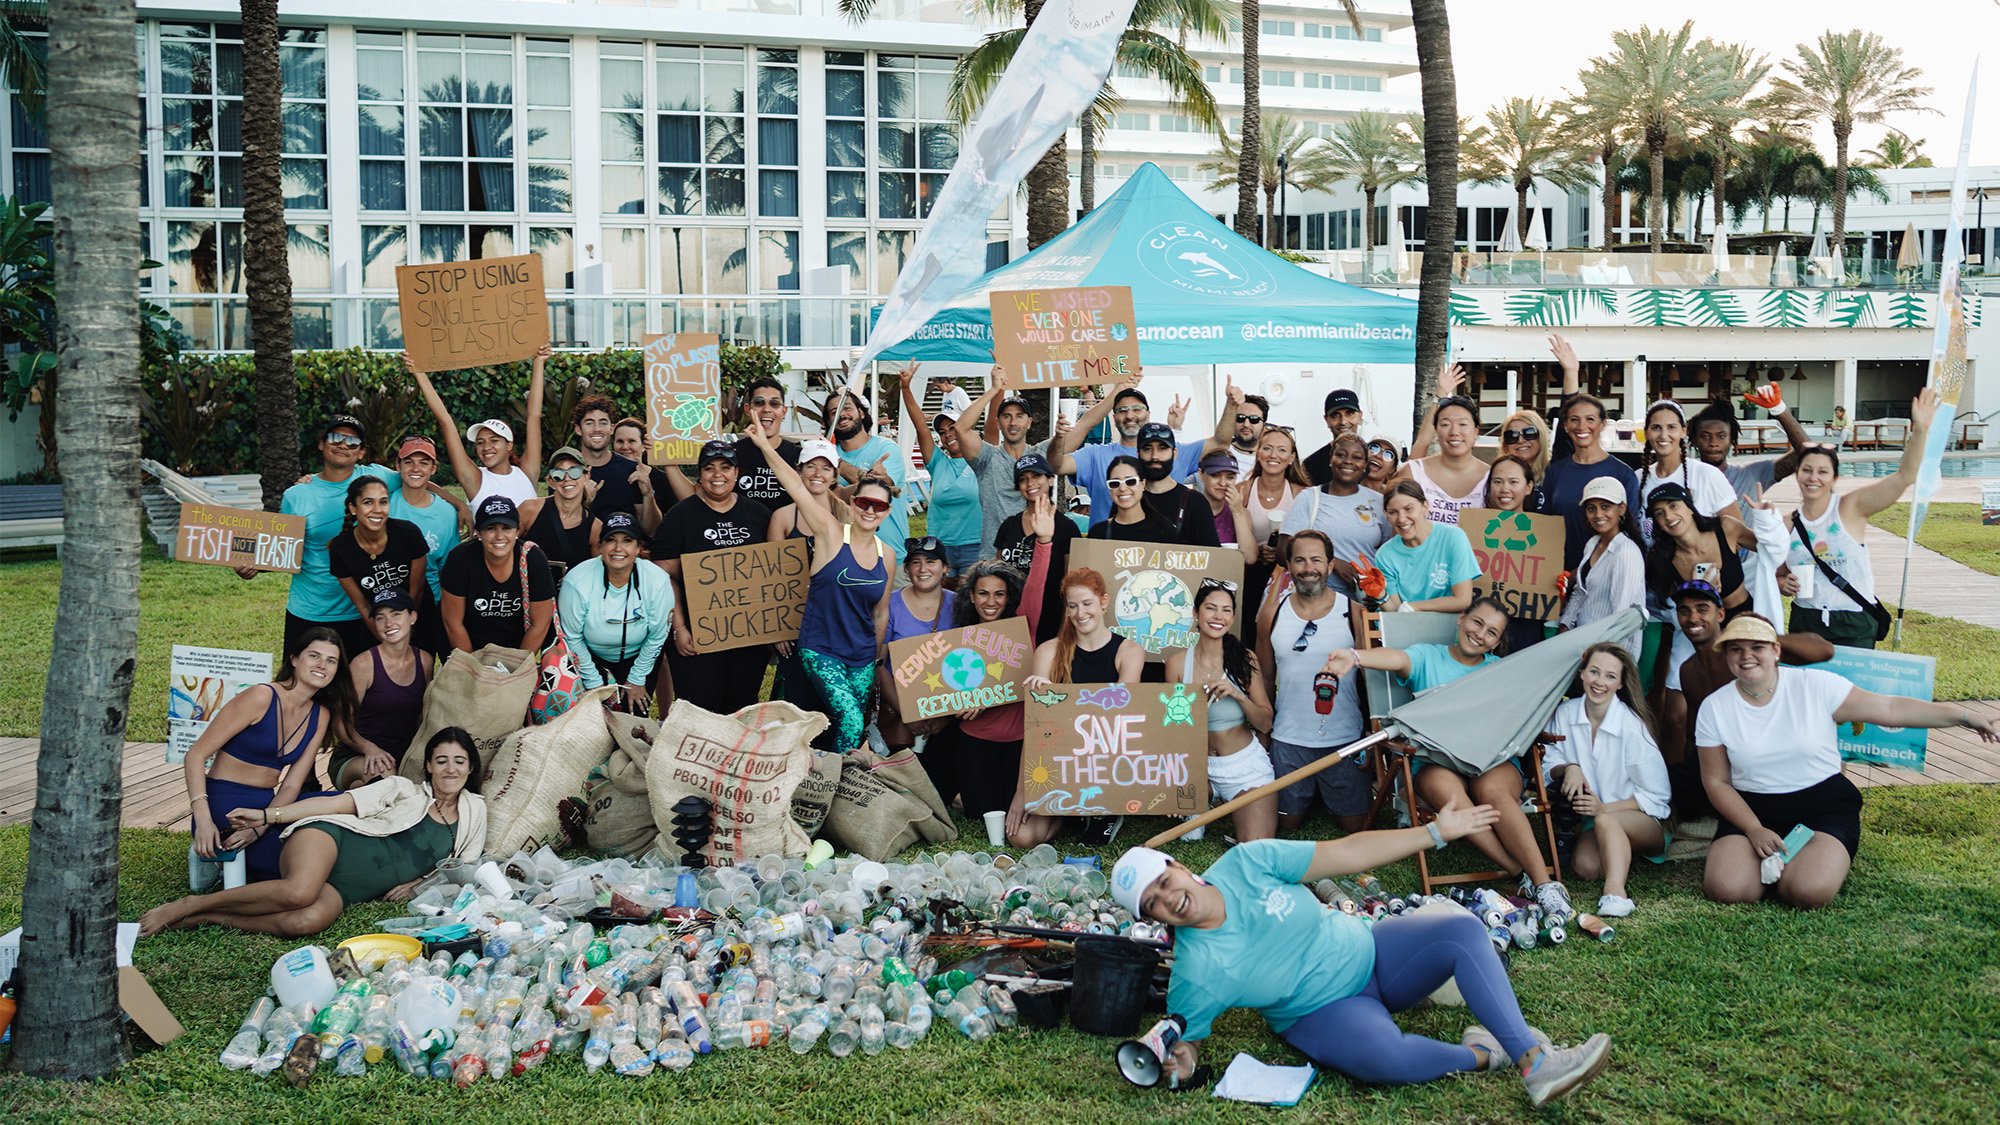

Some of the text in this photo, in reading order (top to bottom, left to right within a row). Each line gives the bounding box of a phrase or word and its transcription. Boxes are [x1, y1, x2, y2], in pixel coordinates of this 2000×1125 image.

[1150, 226, 1228, 250] CLEAN
[413, 263, 529, 295] STOP USING
[1172, 279, 1228, 296] MIAMI
[414, 289, 539, 328] SINGLE USE
[1013, 292, 1042, 312] WE
[1023, 310, 1104, 329] EVERYONE
[430, 320, 528, 354] PLASTIC
[919, 323, 954, 340] BEACHES
[955, 323, 986, 340] START
[1017, 328, 1107, 345] WOULD CARE
[1240, 321, 1413, 342] @cleanmiamibeach
[643, 333, 676, 362] STOP
[1046, 344, 1098, 360] JUST A
[1022, 355, 1131, 384] LITTLE MORE
[756, 467, 775, 475] THE
[747, 490, 781, 499] GROUP
[192, 506, 288, 532] the ocean is for
[1426, 510, 1459, 524] MBASS
[703, 527, 750, 541] OPES
[714, 538, 744, 546] GROUP
[233, 539, 255, 551] NOT
[372, 561, 390, 571] THE
[698, 545, 804, 585] STRAWS
[1114, 546, 1210, 570] SKIP A STRAW
[1473, 549, 1546, 586] DONT
[360, 564, 409, 589] OPES
[372, 578, 404, 593] GROUP
[1491, 581, 1505, 591] BE
[491, 590, 508, 599] THE
[708, 579, 802, 611] ARE FOR
[474, 597, 521, 613] OPES
[697, 603, 807, 647] SUCKERS
[1140, 633, 1162, 654] THE
[894, 626, 1027, 688] REDUCE REUSE
[1871, 659, 1919, 677] Instagram
[916, 681, 1018, 719] REPURPOSE
[1072, 714, 1147, 756] SAVE
[685, 743, 696, 757] 3
[1053, 753, 1189, 787] THE OCEANS
[794, 807, 820, 819] ATLAS
[714, 841, 734, 852] DE
